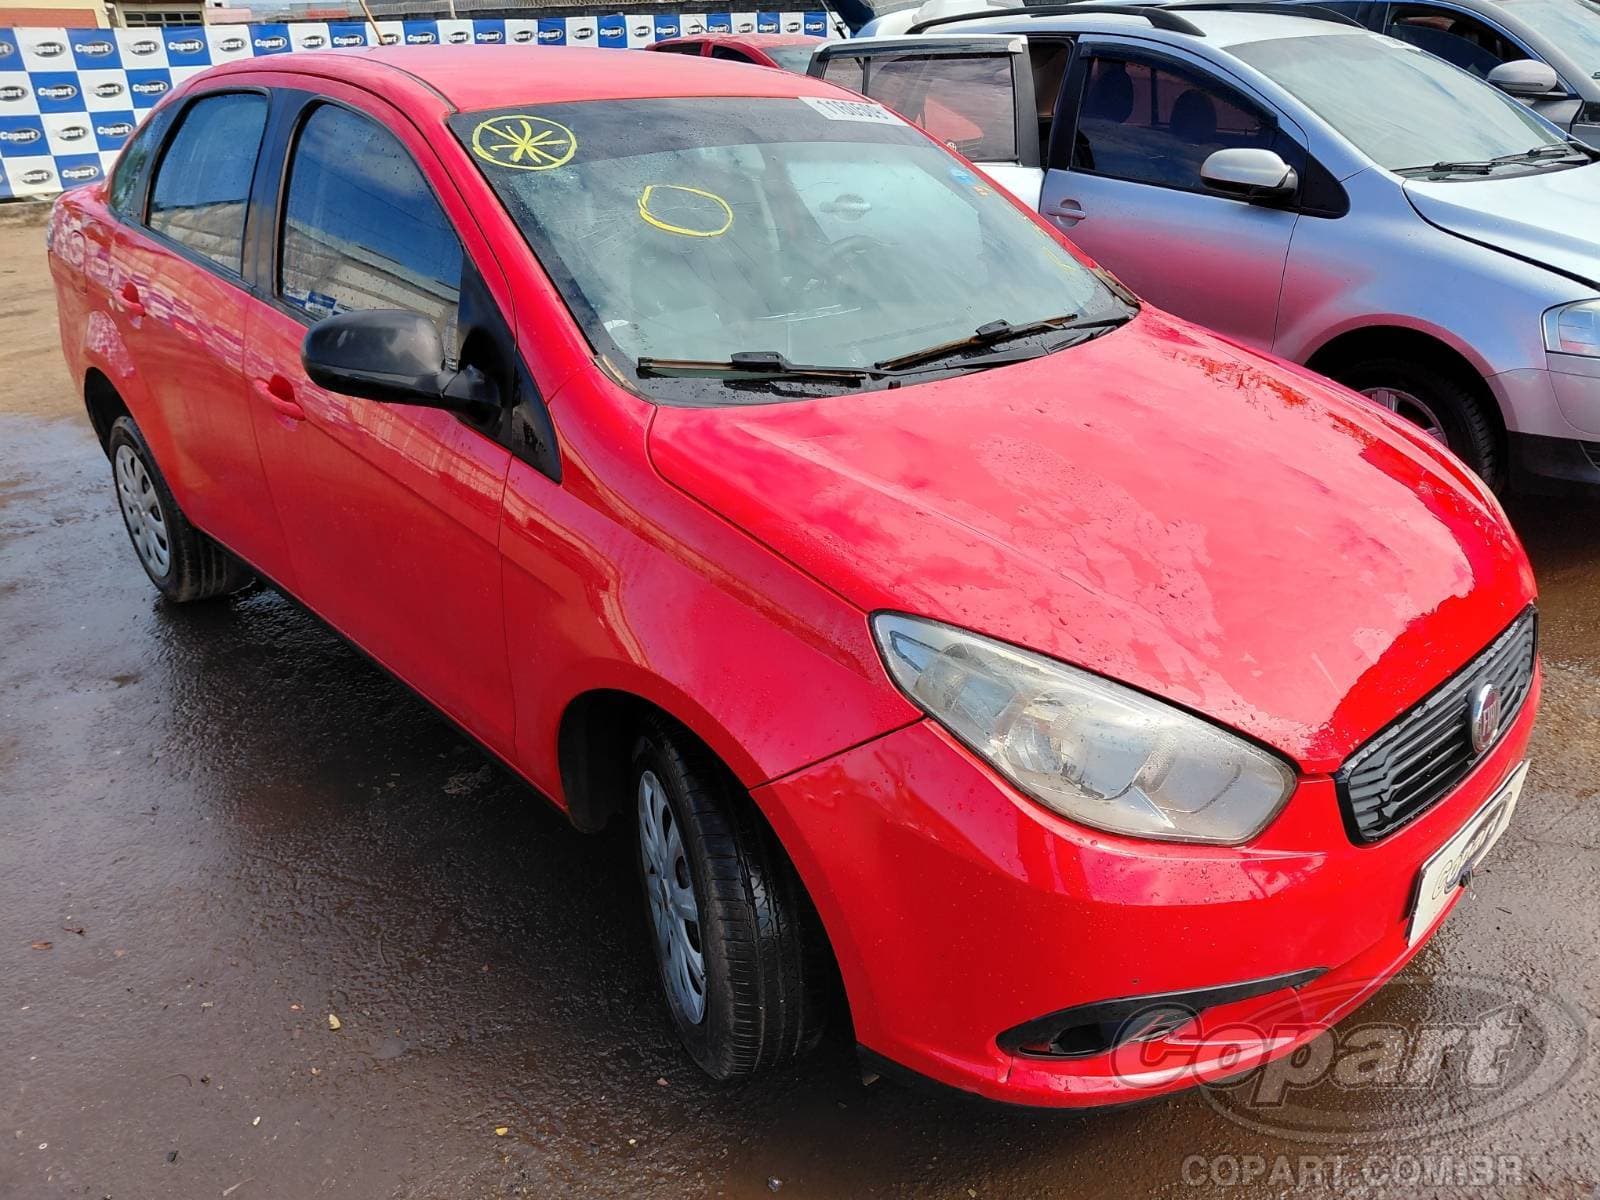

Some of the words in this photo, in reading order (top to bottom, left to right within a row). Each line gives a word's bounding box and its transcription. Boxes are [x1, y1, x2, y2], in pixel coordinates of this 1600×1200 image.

[538, 31, 561, 40] Copart
[600, 29, 622, 37] Copart
[656, 27, 676, 35] Copart
[332, 36, 361, 46] Copart
[407, 35, 433, 44] Copart
[476, 33, 500, 42] Copart
[168, 41, 200, 51] Copart
[254, 39, 284, 48] Copart
[75, 44, 109, 54] Copart
[38, 87, 73, 97] Copart
[132, 83, 164, 93] Copart
[97, 126, 129, 136] Copart
[0, 131, 38, 142] Copart
[62, 169, 95, 179] Copart
